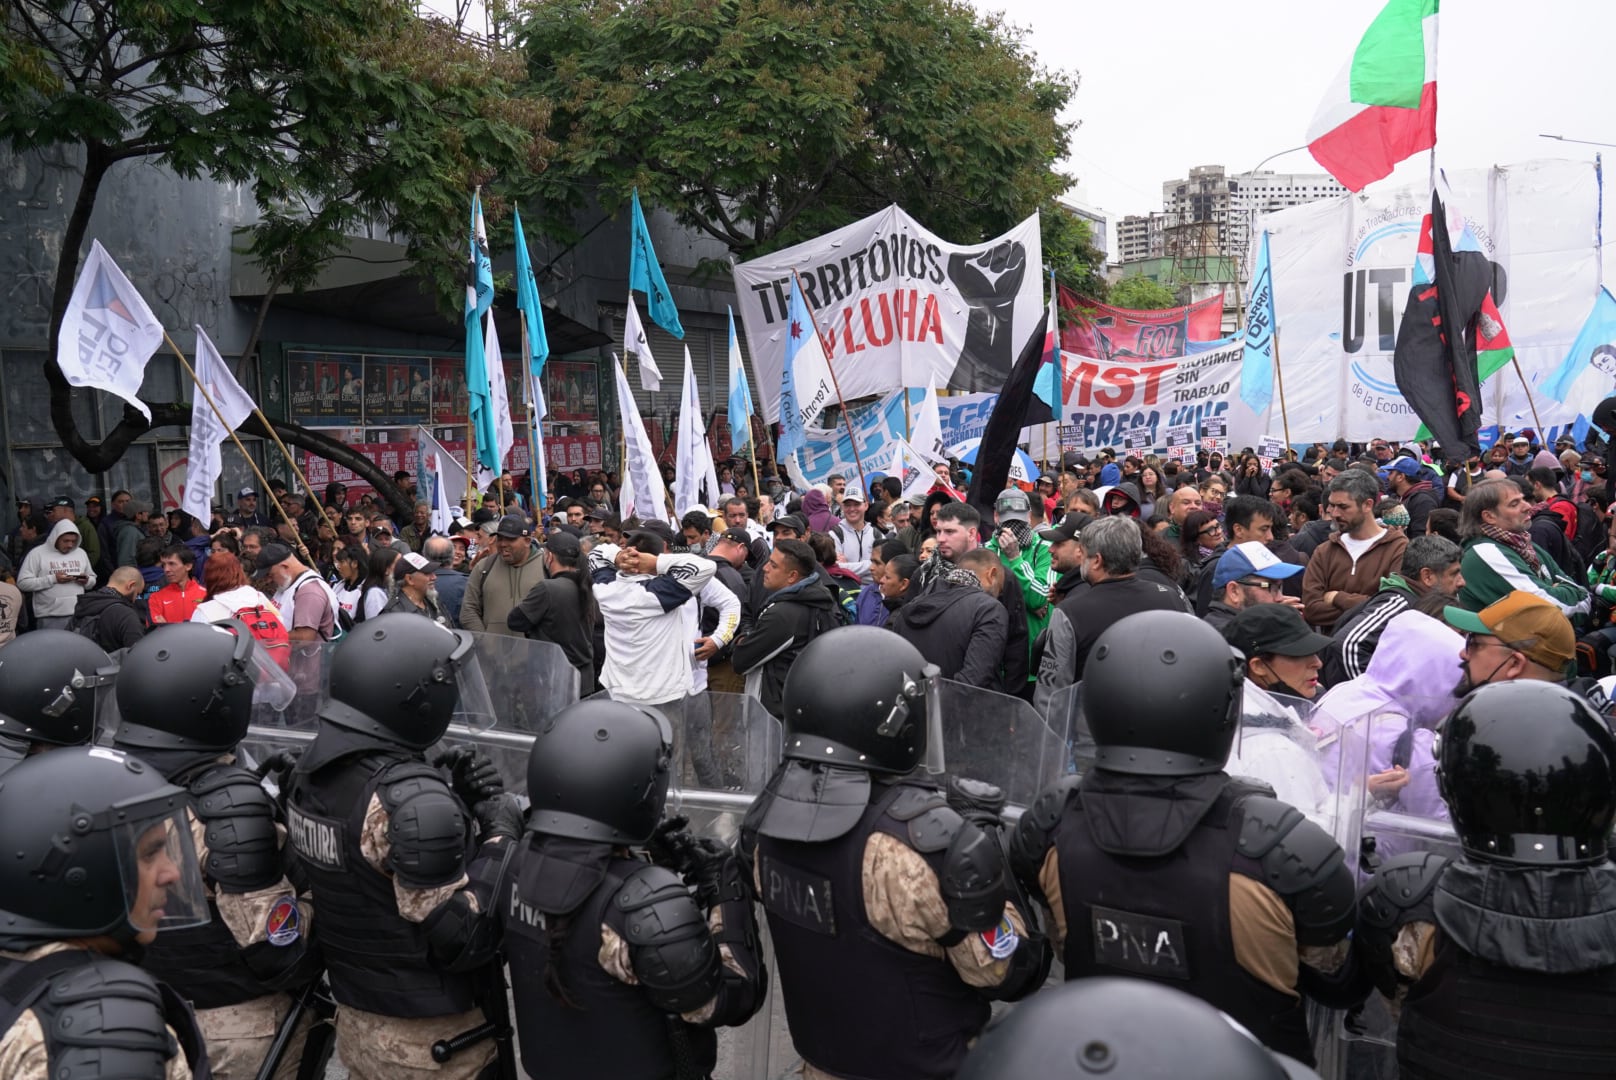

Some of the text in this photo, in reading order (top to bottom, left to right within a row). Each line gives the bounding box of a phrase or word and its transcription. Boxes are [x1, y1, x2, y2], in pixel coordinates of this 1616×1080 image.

[1136, 325, 1178, 355] FOL
[1173, 381, 1231, 403] TRABAJO
[1175, 370, 1199, 384] SIN
[1351, 382, 1417, 415] de la Econo
[510, 882, 546, 930] PNA
[770, 870, 823, 923] PNA
[1096, 918, 1180, 966] PNA
